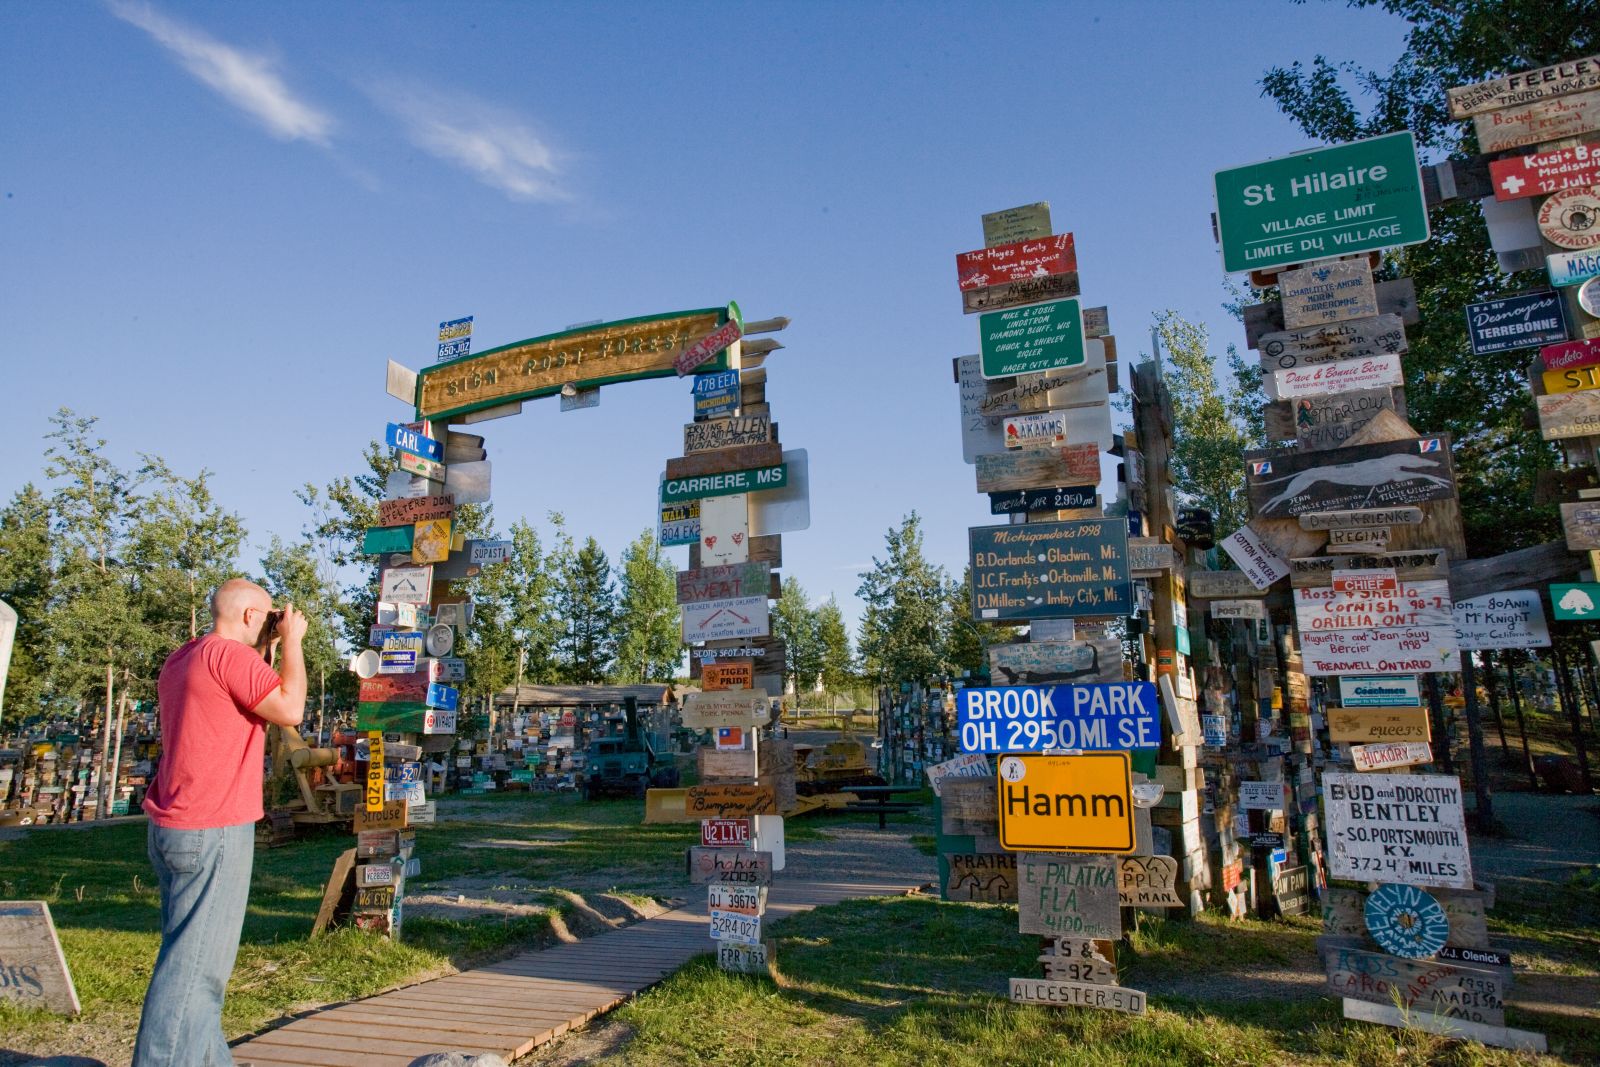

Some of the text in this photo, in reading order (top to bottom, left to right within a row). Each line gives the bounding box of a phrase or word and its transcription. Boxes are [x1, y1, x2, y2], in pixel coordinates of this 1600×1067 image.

[1552, 79, 1584, 93] NOVA
[1462, 86, 1504, 110] BERNIE
[1493, 110, 1533, 125] Boyd
[1243, 165, 1388, 206] St Hilaire
[1560, 172, 1591, 189] Juli
[1262, 203, 1376, 234] VILLAGE LIMIT
[1245, 224, 1401, 261] LIMITE DU VILLAGE
[966, 251, 984, 261] The
[1023, 243, 1046, 255] Family
[1001, 305, 1056, 321] MIKE & JOSIE
[1007, 315, 1049, 329] LINDSTROM
[990, 329, 1024, 341] DIAMOND
[1374, 330, 1401, 346] 1998
[1477, 318, 1558, 340] TERREBONNE
[996, 342, 1020, 353] CHUCK
[1033, 335, 1065, 347] SHIRLEY
[448, 332, 690, 396] SIGN POST FOREST
[1054, 357, 1068, 366] WIS
[1314, 370, 1323, 379] &
[1325, 365, 1359, 379] Bonnie
[1362, 361, 1389, 373] Beers
[697, 373, 737, 394] 478 EEA
[687, 416, 767, 435] IRVING ALLEN
[396, 429, 419, 453] CARL
[667, 468, 782, 495] CARRIERE, MS
[381, 496, 451, 515] THE DON
[662, 508, 686, 521] WALL
[662, 528, 680, 541] 804
[1078, 525, 1101, 538] 1998
[1334, 531, 1388, 542] REGINA
[474, 545, 507, 559] SUPASTA
[1233, 532, 1279, 582] COTTON PICKERS
[681, 579, 742, 600] SWEAT
[1301, 588, 1337, 600] Ross
[1345, 580, 1385, 591] CHIEF
[1047, 589, 1075, 607] Imlay
[1330, 643, 1371, 654] Bercier
[1377, 660, 1432, 672] ONTARIO
[720, 667, 749, 686] TIGER PRIDE
[362, 682, 384, 692] FROM
[1354, 686, 1407, 696] Coachmen
[968, 688, 1057, 720] BROOK
[962, 721, 1001, 751] OH.
[1007, 718, 1076, 750] 2950
[1119, 717, 1160, 748] S.E.
[1363, 747, 1409, 765] HICKORY
[1007, 785, 1124, 817] Hamm
[1331, 784, 1457, 804] BUD and DOROTHY
[1351, 803, 1440, 823] BENTLEY
[704, 825, 748, 841] U2 LIVE
[721, 871, 757, 883] 2003
[1046, 862, 1117, 889] PALATKA
[1408, 861, 1458, 877] MILES
[1290, 872, 1305, 891] PAW
[728, 894, 757, 909] 39679
[1462, 950, 1501, 964] Olenick
[1014, 983, 1106, 1006] ALCESTER
[1430, 988, 1504, 1011] MADISON
